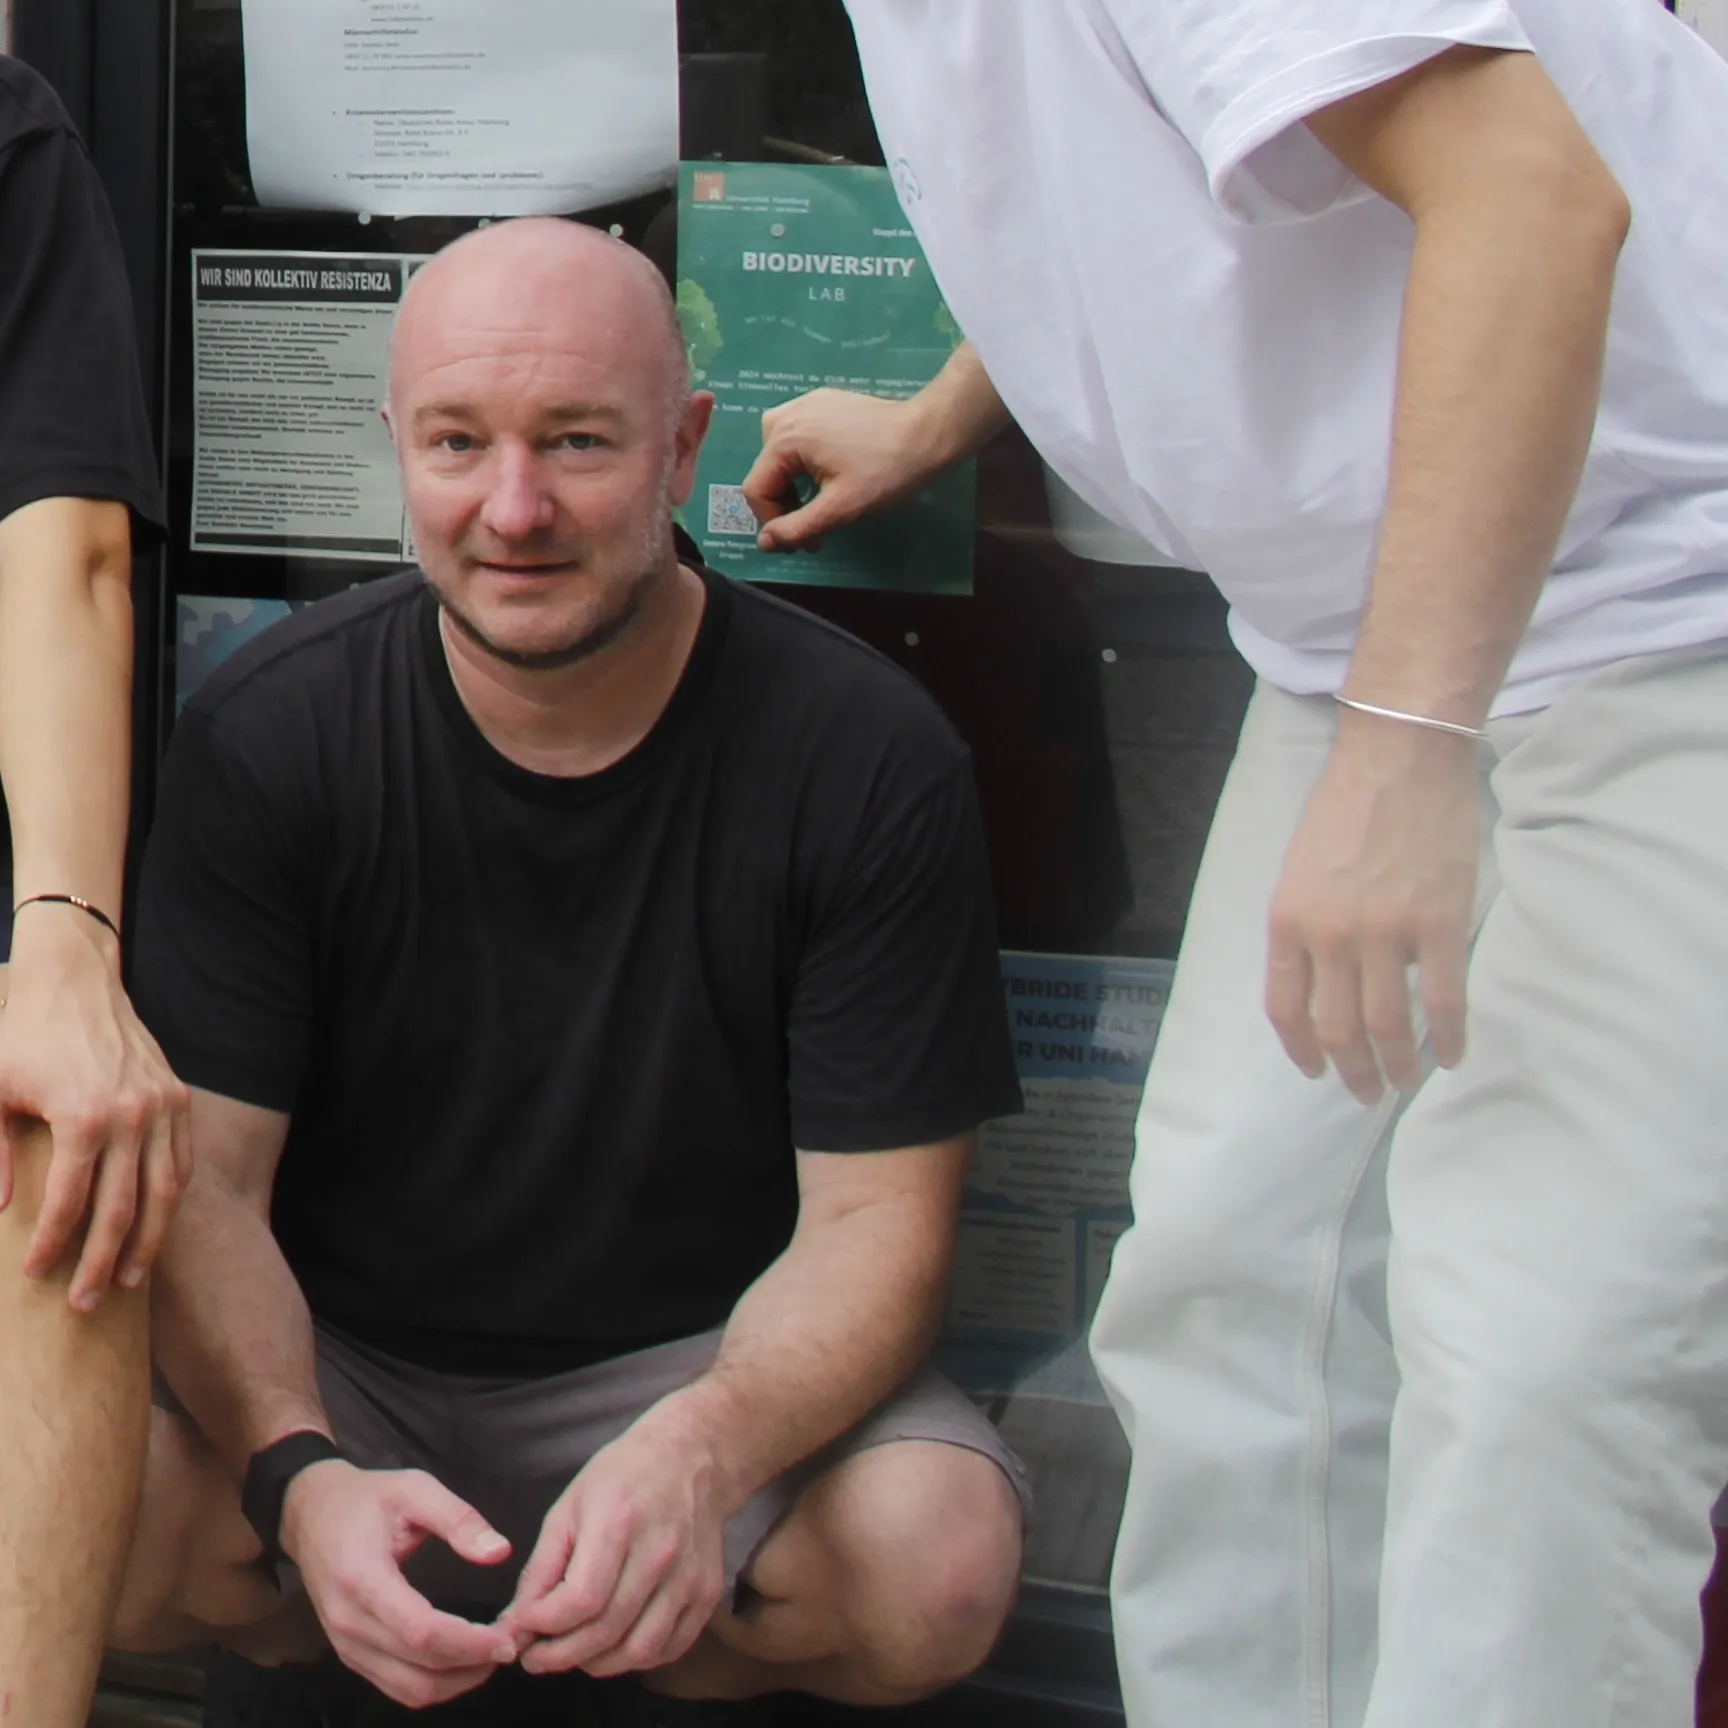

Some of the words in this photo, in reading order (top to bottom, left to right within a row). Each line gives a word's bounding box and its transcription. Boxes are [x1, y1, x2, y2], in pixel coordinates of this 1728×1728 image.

[742, 250, 917, 278] BIODIVERSITY
[200, 267, 223, 287] WIR
[225, 268, 251, 288] SIND
[254, 269, 319, 290] KOLLEKTIV
[321, 270, 392, 292] RESISTENZA
[808, 286, 846, 302] LAB
[1010, 978, 1089, 1001] BRIDE
[1040, 1042, 1085, 1064] UNI
